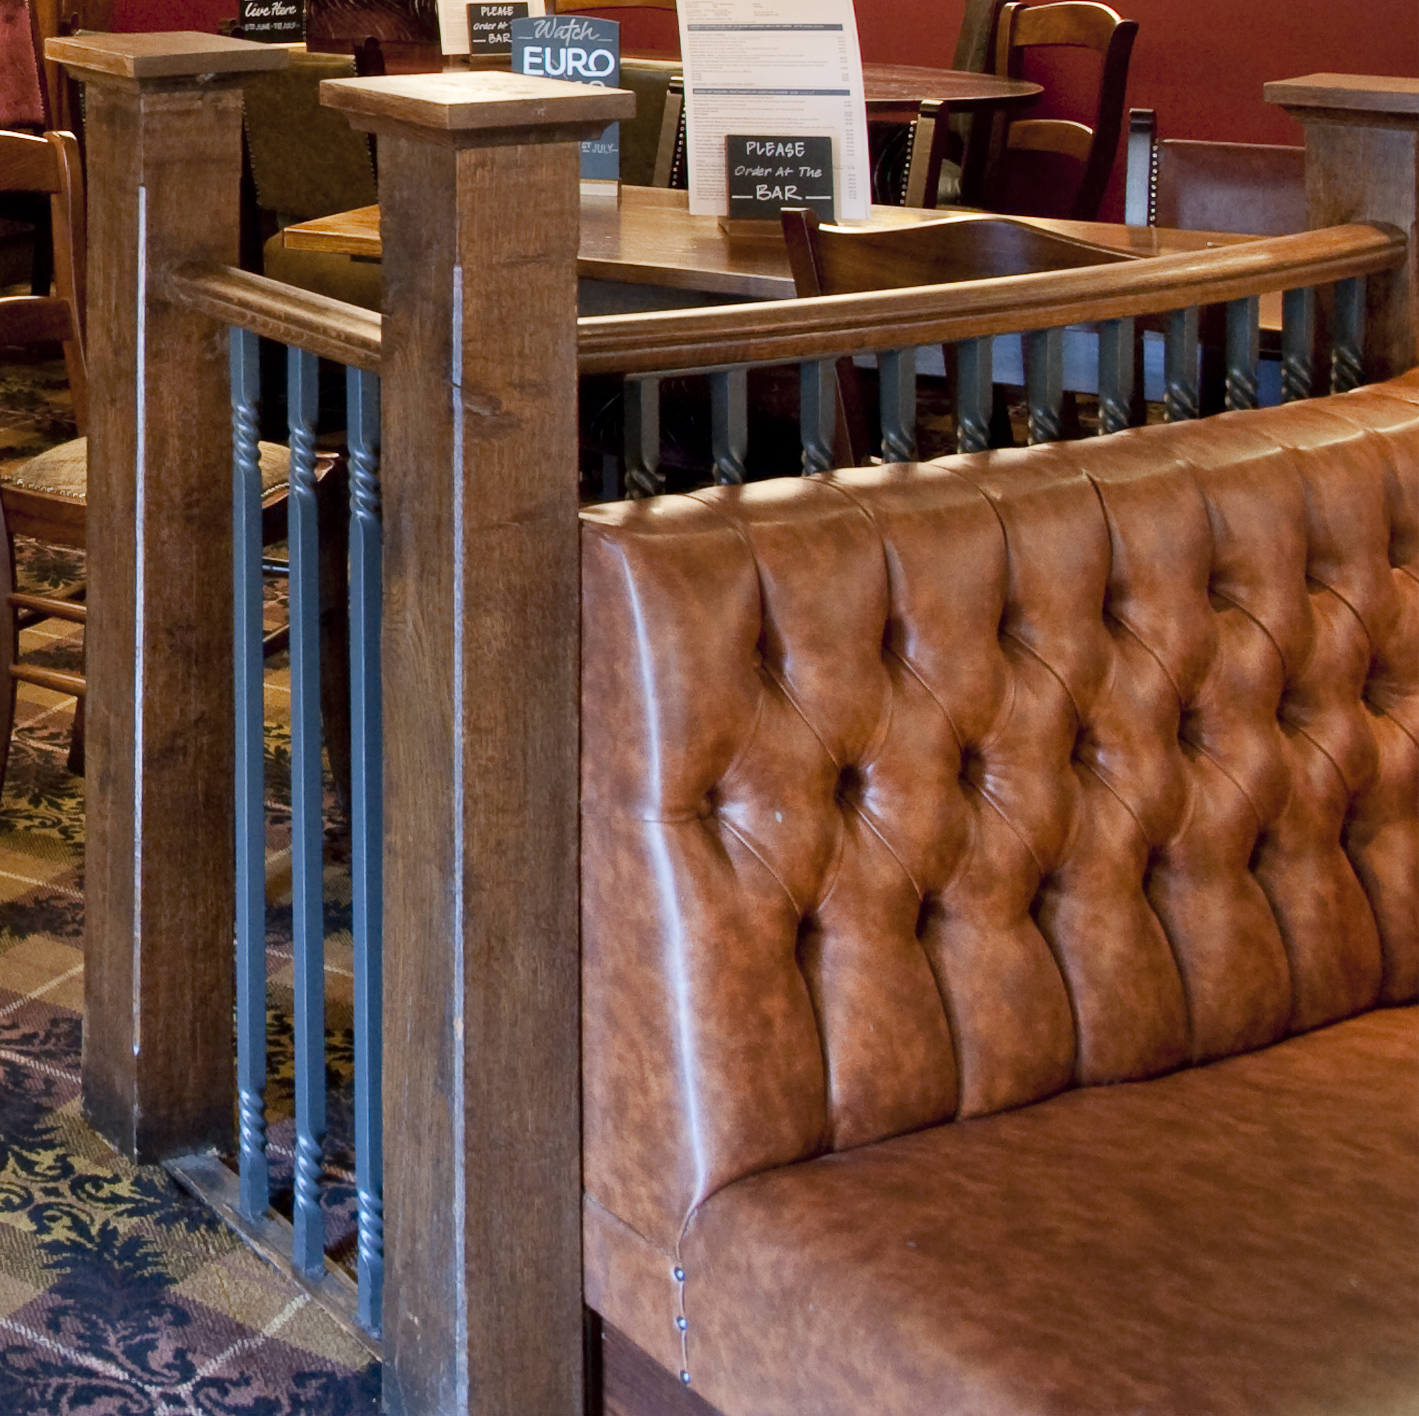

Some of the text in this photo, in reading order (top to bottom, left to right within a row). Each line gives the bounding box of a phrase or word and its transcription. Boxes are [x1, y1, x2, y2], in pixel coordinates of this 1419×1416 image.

[245, 1, 297, 18] Live Here
[480, 6, 514, 17] PLEASE
[473, 21, 497, 30] Order
[497, 21, 509, 30] At
[533, 17, 601, 47] Watch
[488, 32, 513, 44] BAR
[523, 46, 616, 77] EURO
[593, 142, 615, 154] JULY
[746, 141, 805, 158] PLEASE
[734, 165, 823, 178] Order At The
[756, 184, 803, 201] BAR
